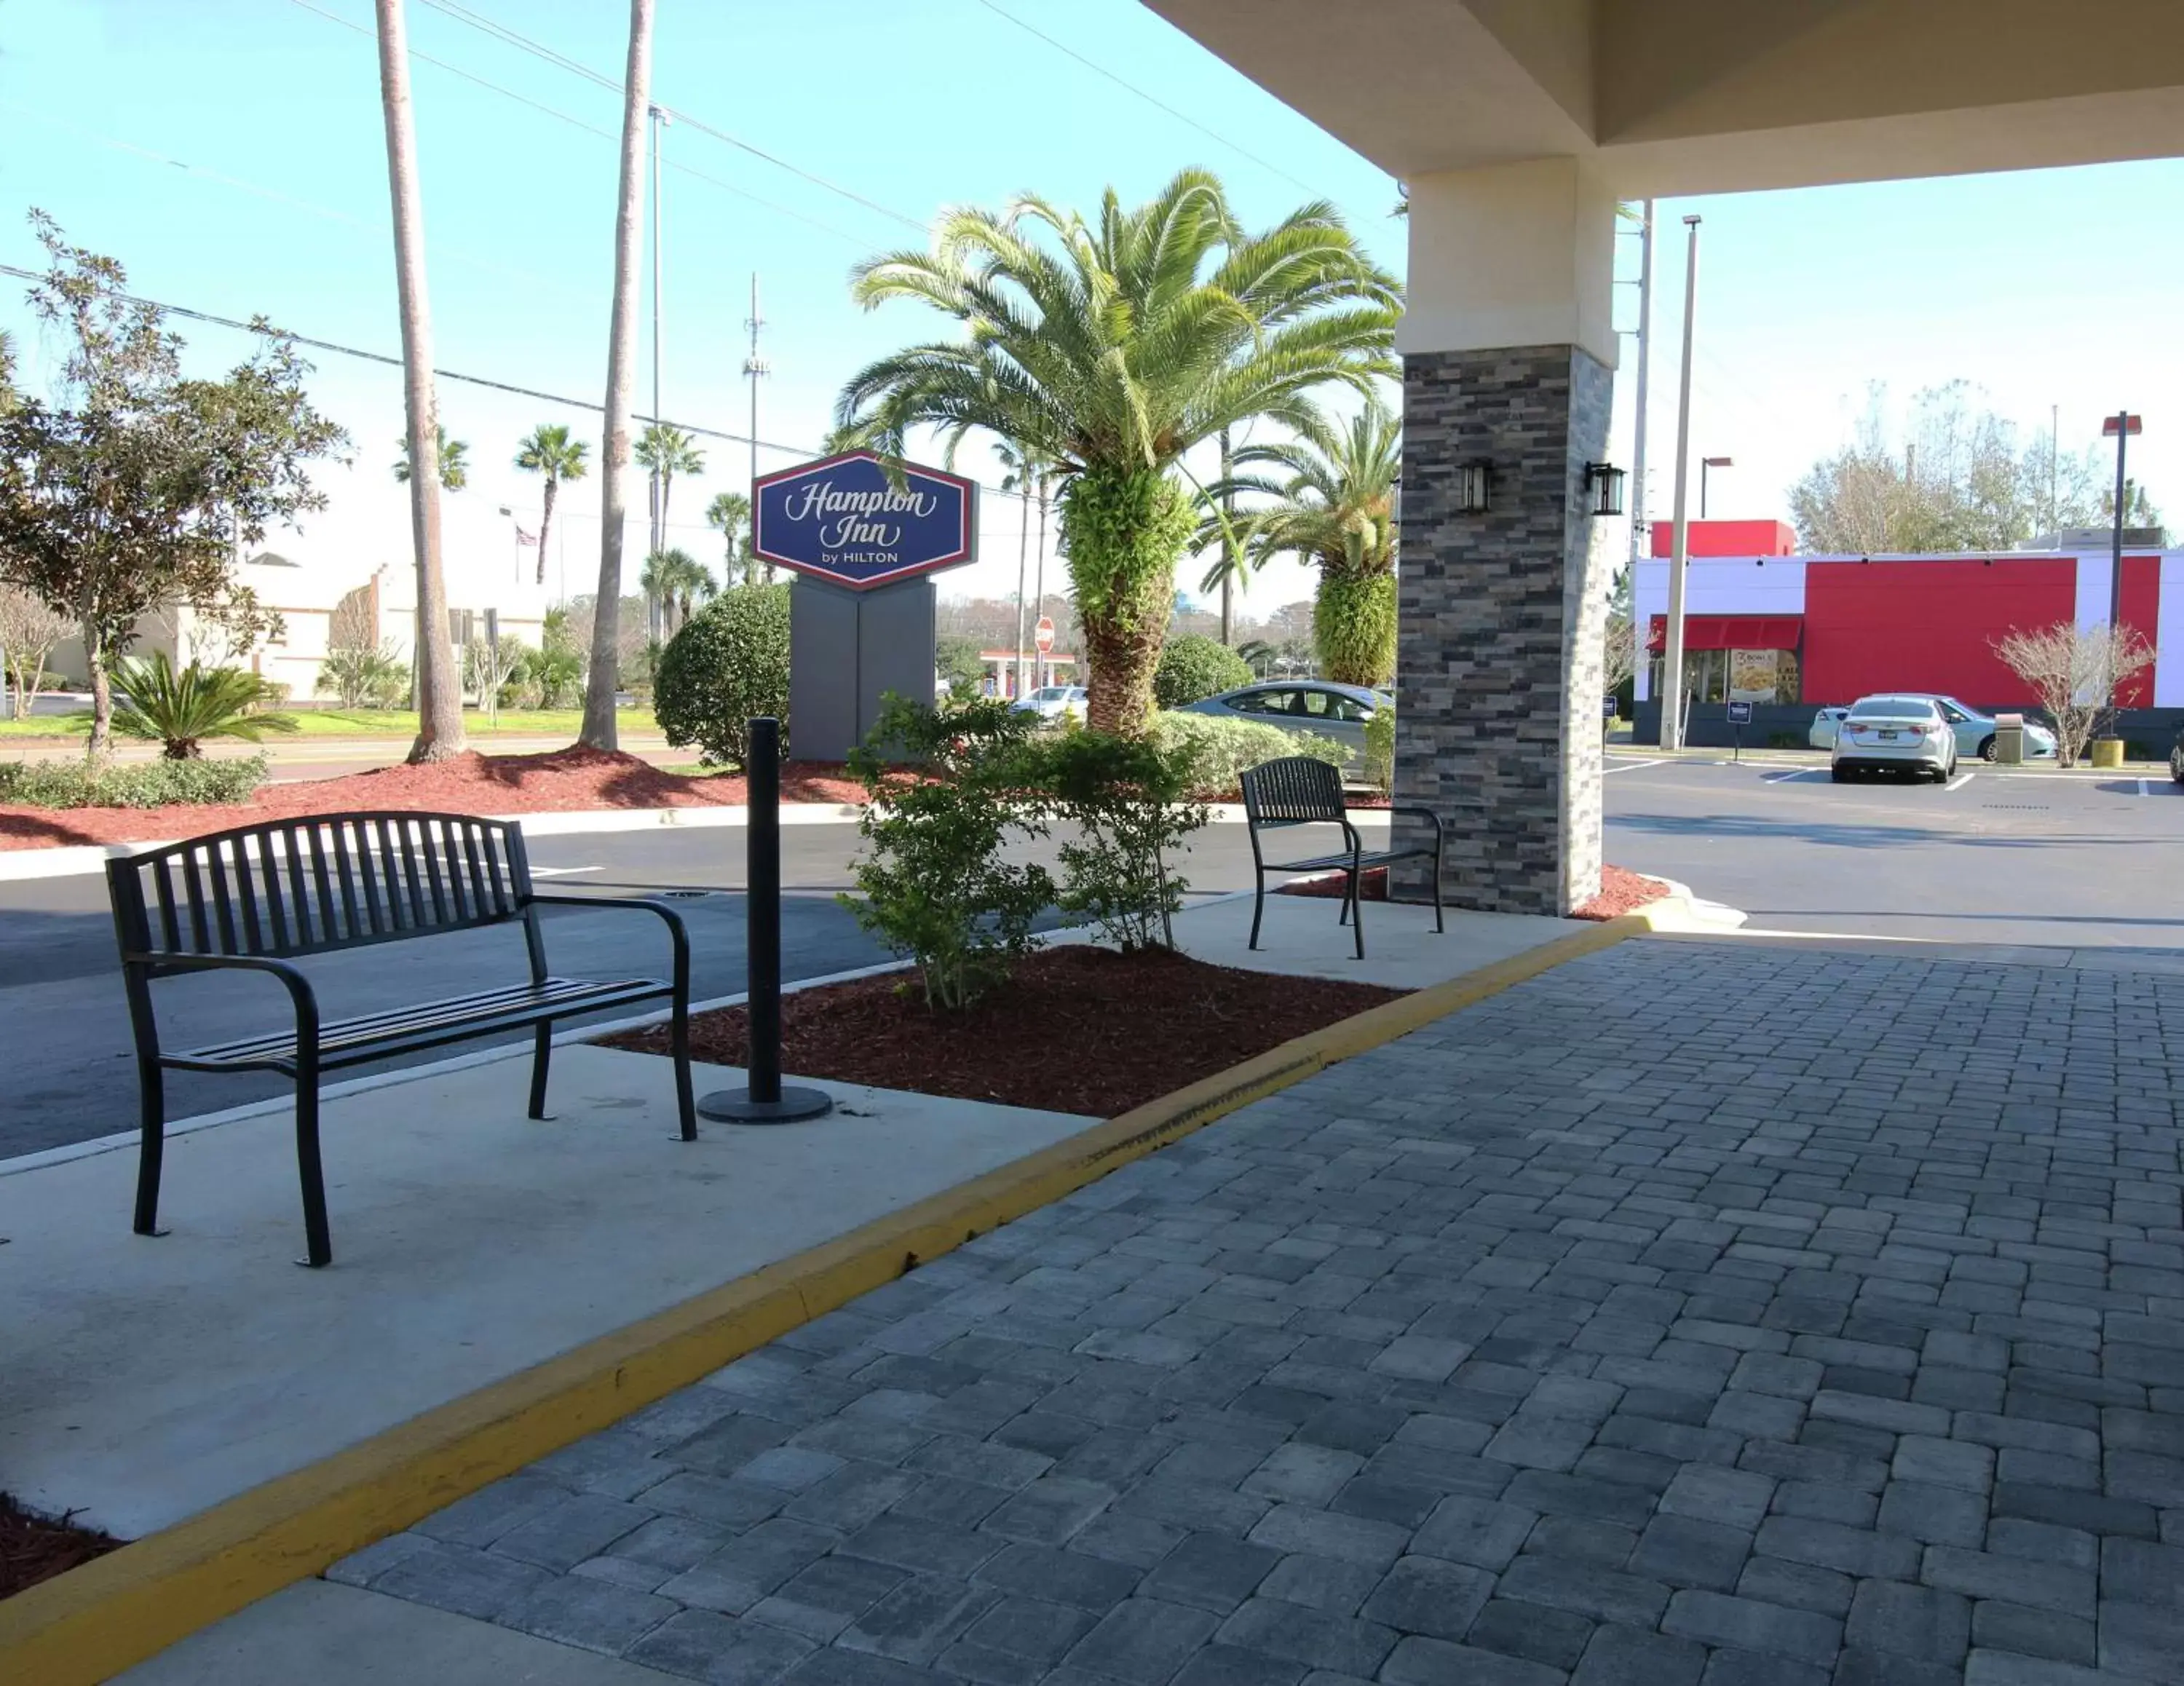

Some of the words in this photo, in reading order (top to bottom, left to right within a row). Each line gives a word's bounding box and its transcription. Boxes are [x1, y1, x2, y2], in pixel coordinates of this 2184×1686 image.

[785, 481, 937, 521] Hampton
[820, 515, 901, 548] Inn
[822, 553, 838, 564] by
[844, 553, 898, 563] HILTON
